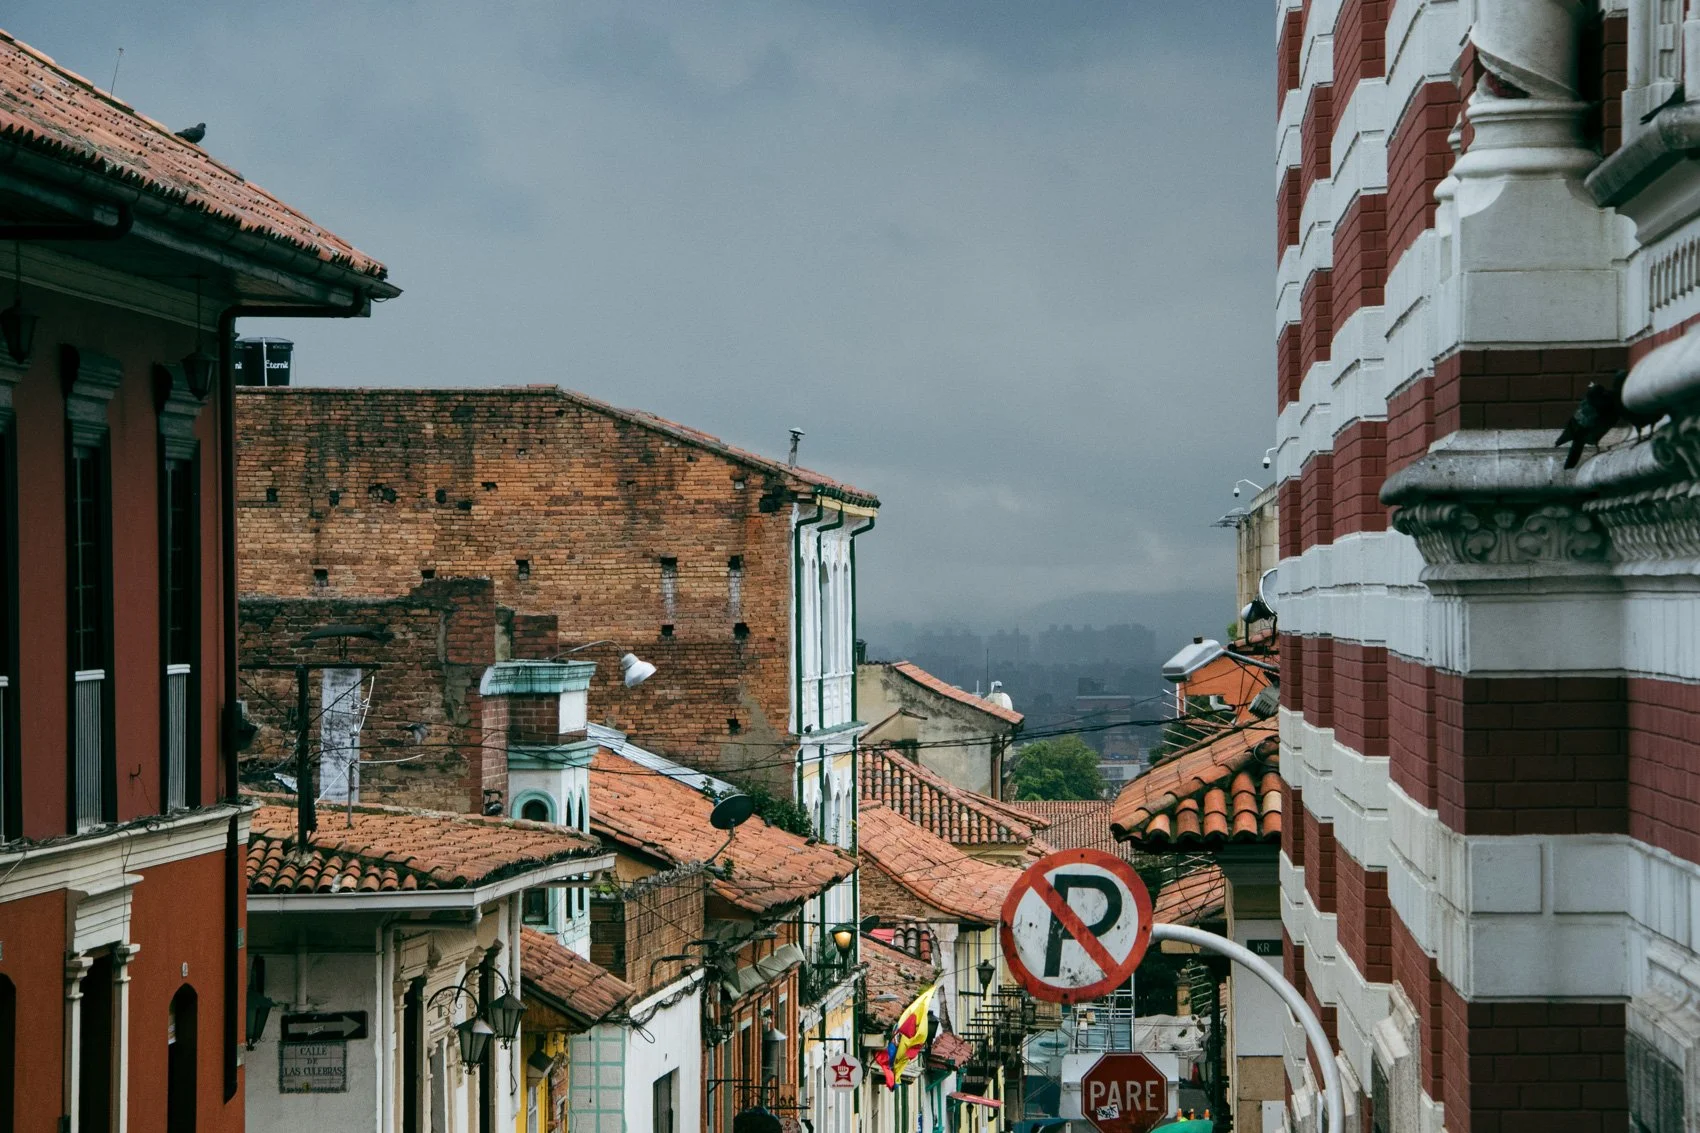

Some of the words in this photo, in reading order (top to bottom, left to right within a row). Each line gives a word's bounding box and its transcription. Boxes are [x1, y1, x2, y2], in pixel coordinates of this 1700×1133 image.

[1044, 874, 1122, 977] P
[1257, 943, 1270, 953] KR
[300, 1047, 327, 1056] CALLE
[284, 1067, 300, 1077] LAS
[303, 1066, 343, 1077] CULEBRAS
[1089, 1080, 1159, 1112] PARE
